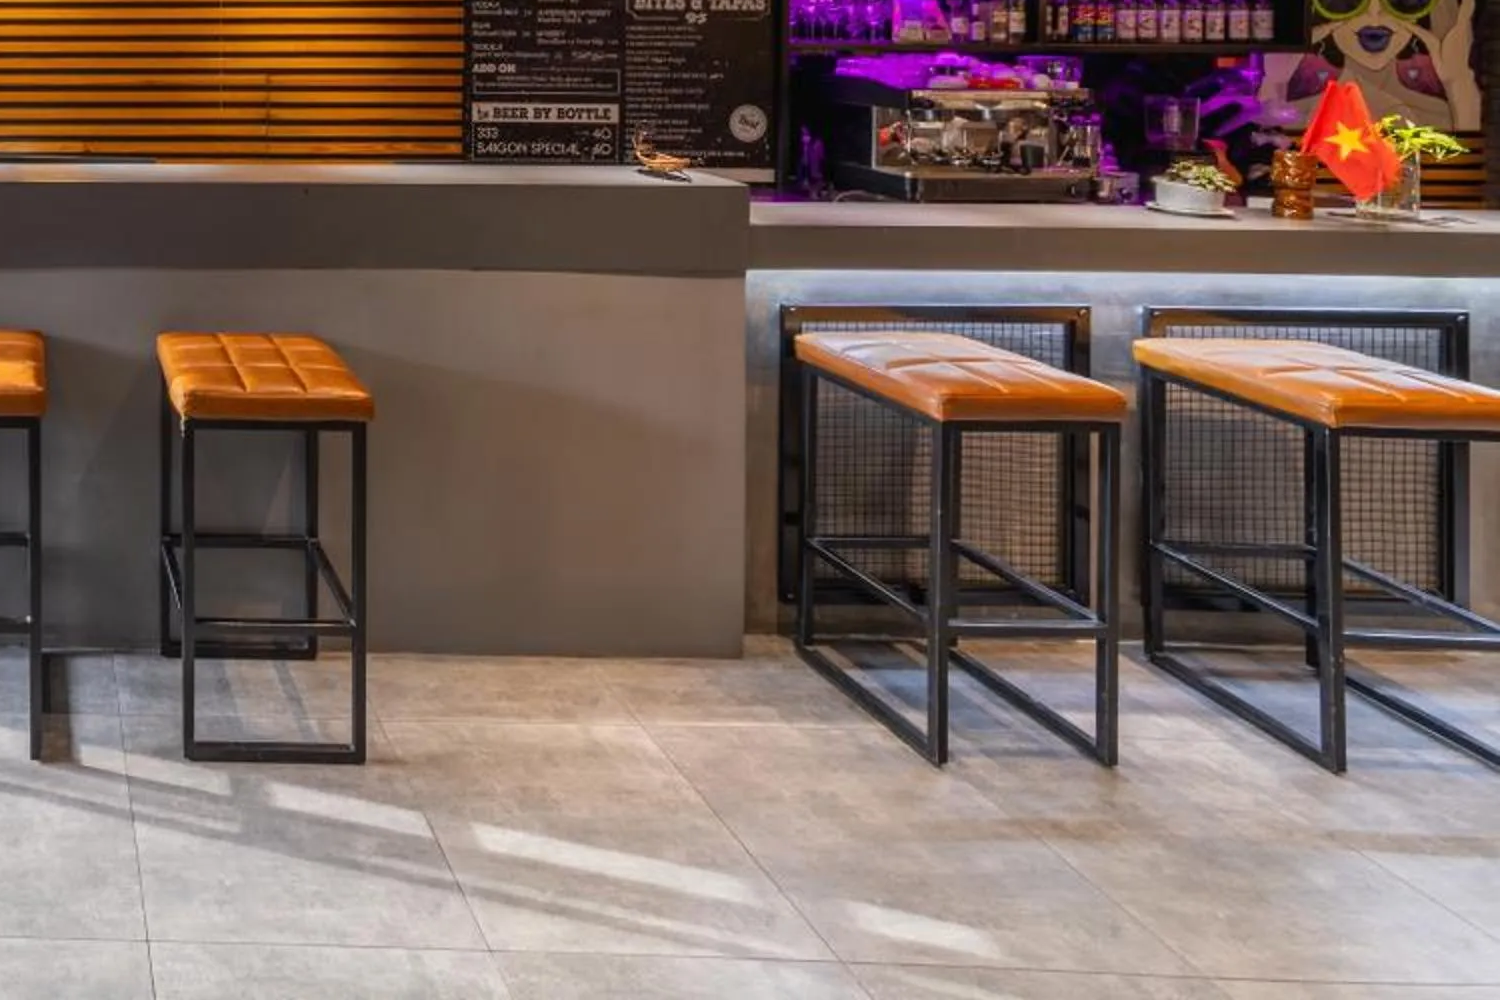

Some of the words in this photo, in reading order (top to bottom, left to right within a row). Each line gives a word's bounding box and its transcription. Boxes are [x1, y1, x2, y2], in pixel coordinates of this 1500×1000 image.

[472, 63, 496, 74] ADD
[498, 63, 517, 74] ON
[493, 106, 529, 120] BEER
[533, 106, 552, 120] BY
[557, 106, 611, 120] BOTTLE
[476, 141, 528, 155] SAIGON
[530, 141, 581, 156] SPECIAL
